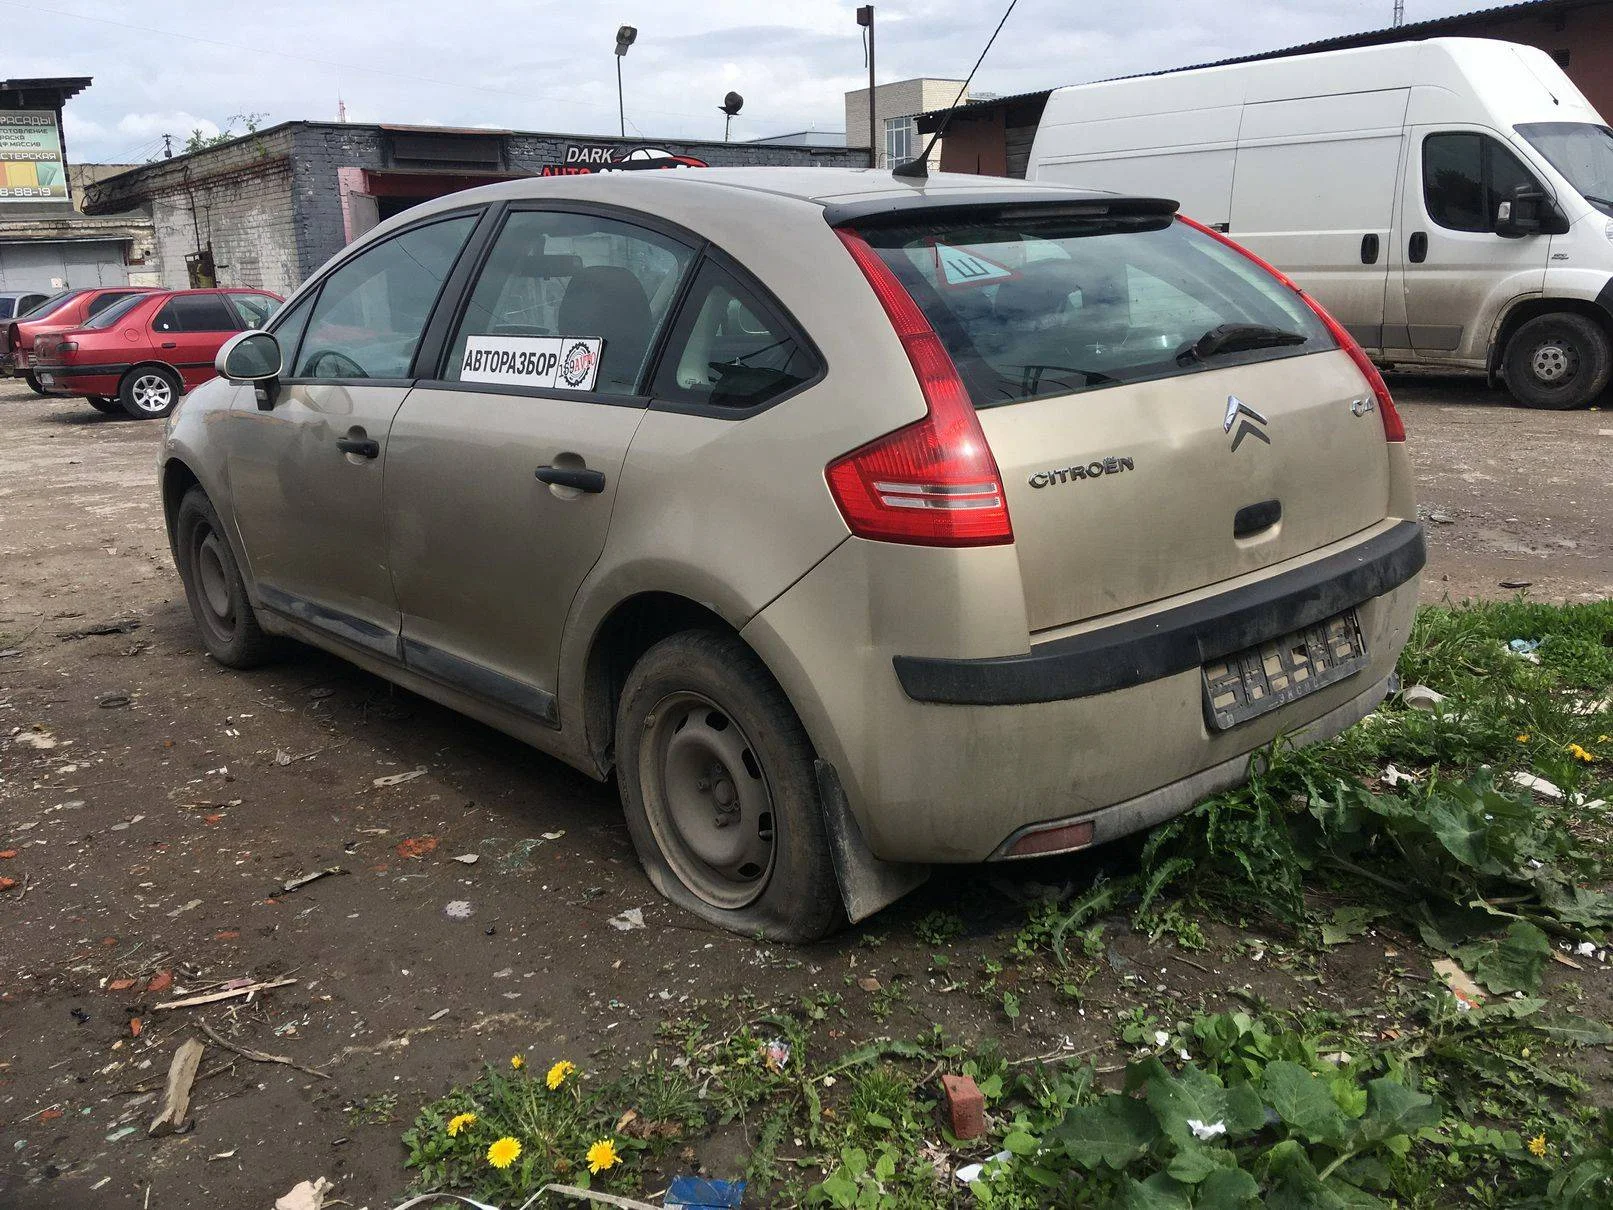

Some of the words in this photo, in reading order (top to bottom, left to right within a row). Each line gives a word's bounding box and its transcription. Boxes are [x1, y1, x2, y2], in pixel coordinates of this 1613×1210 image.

[567, 147, 614, 164] DARK
[0, 187, 51, 196] 8-88-19
[463, 349, 557, 377] АВТОРАЗБОР
[1028, 456, 1135, 489] CITROËN
